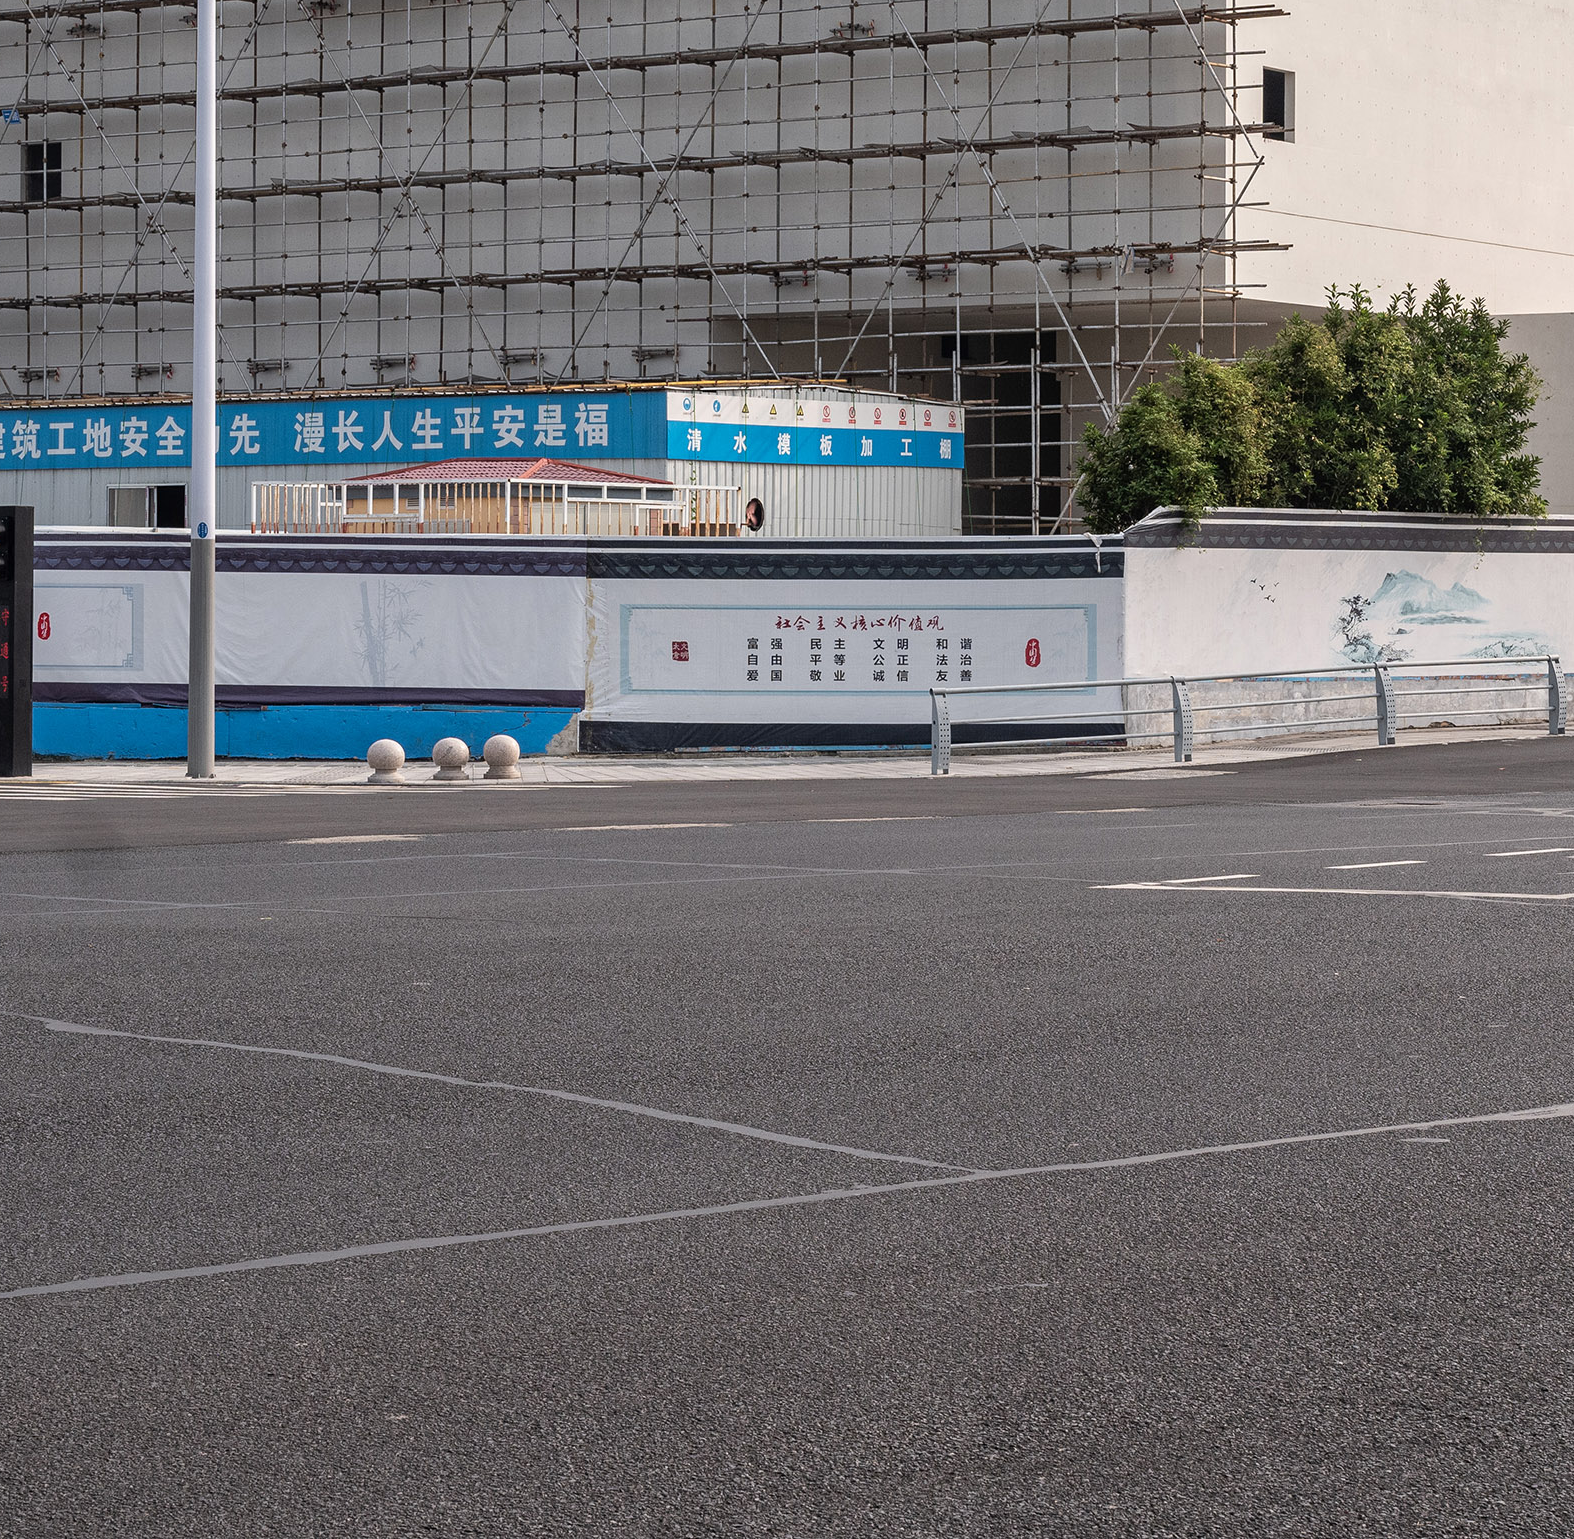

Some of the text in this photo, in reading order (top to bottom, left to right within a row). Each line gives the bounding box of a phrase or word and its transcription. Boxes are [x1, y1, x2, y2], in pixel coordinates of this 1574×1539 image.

[294, 402, 609, 454] 漫长人生平安是福
[687, 427, 952, 460] 清水模板加工棚
[775, 614, 945, 632] 社会主义核心价值观
[746, 638, 973, 650] 富强 民主 文明 和谐
[746, 654, 973, 666] 自由 平等 公正 法治
[746, 670, 973, 682] 爱国 敬业 诚信 友善
